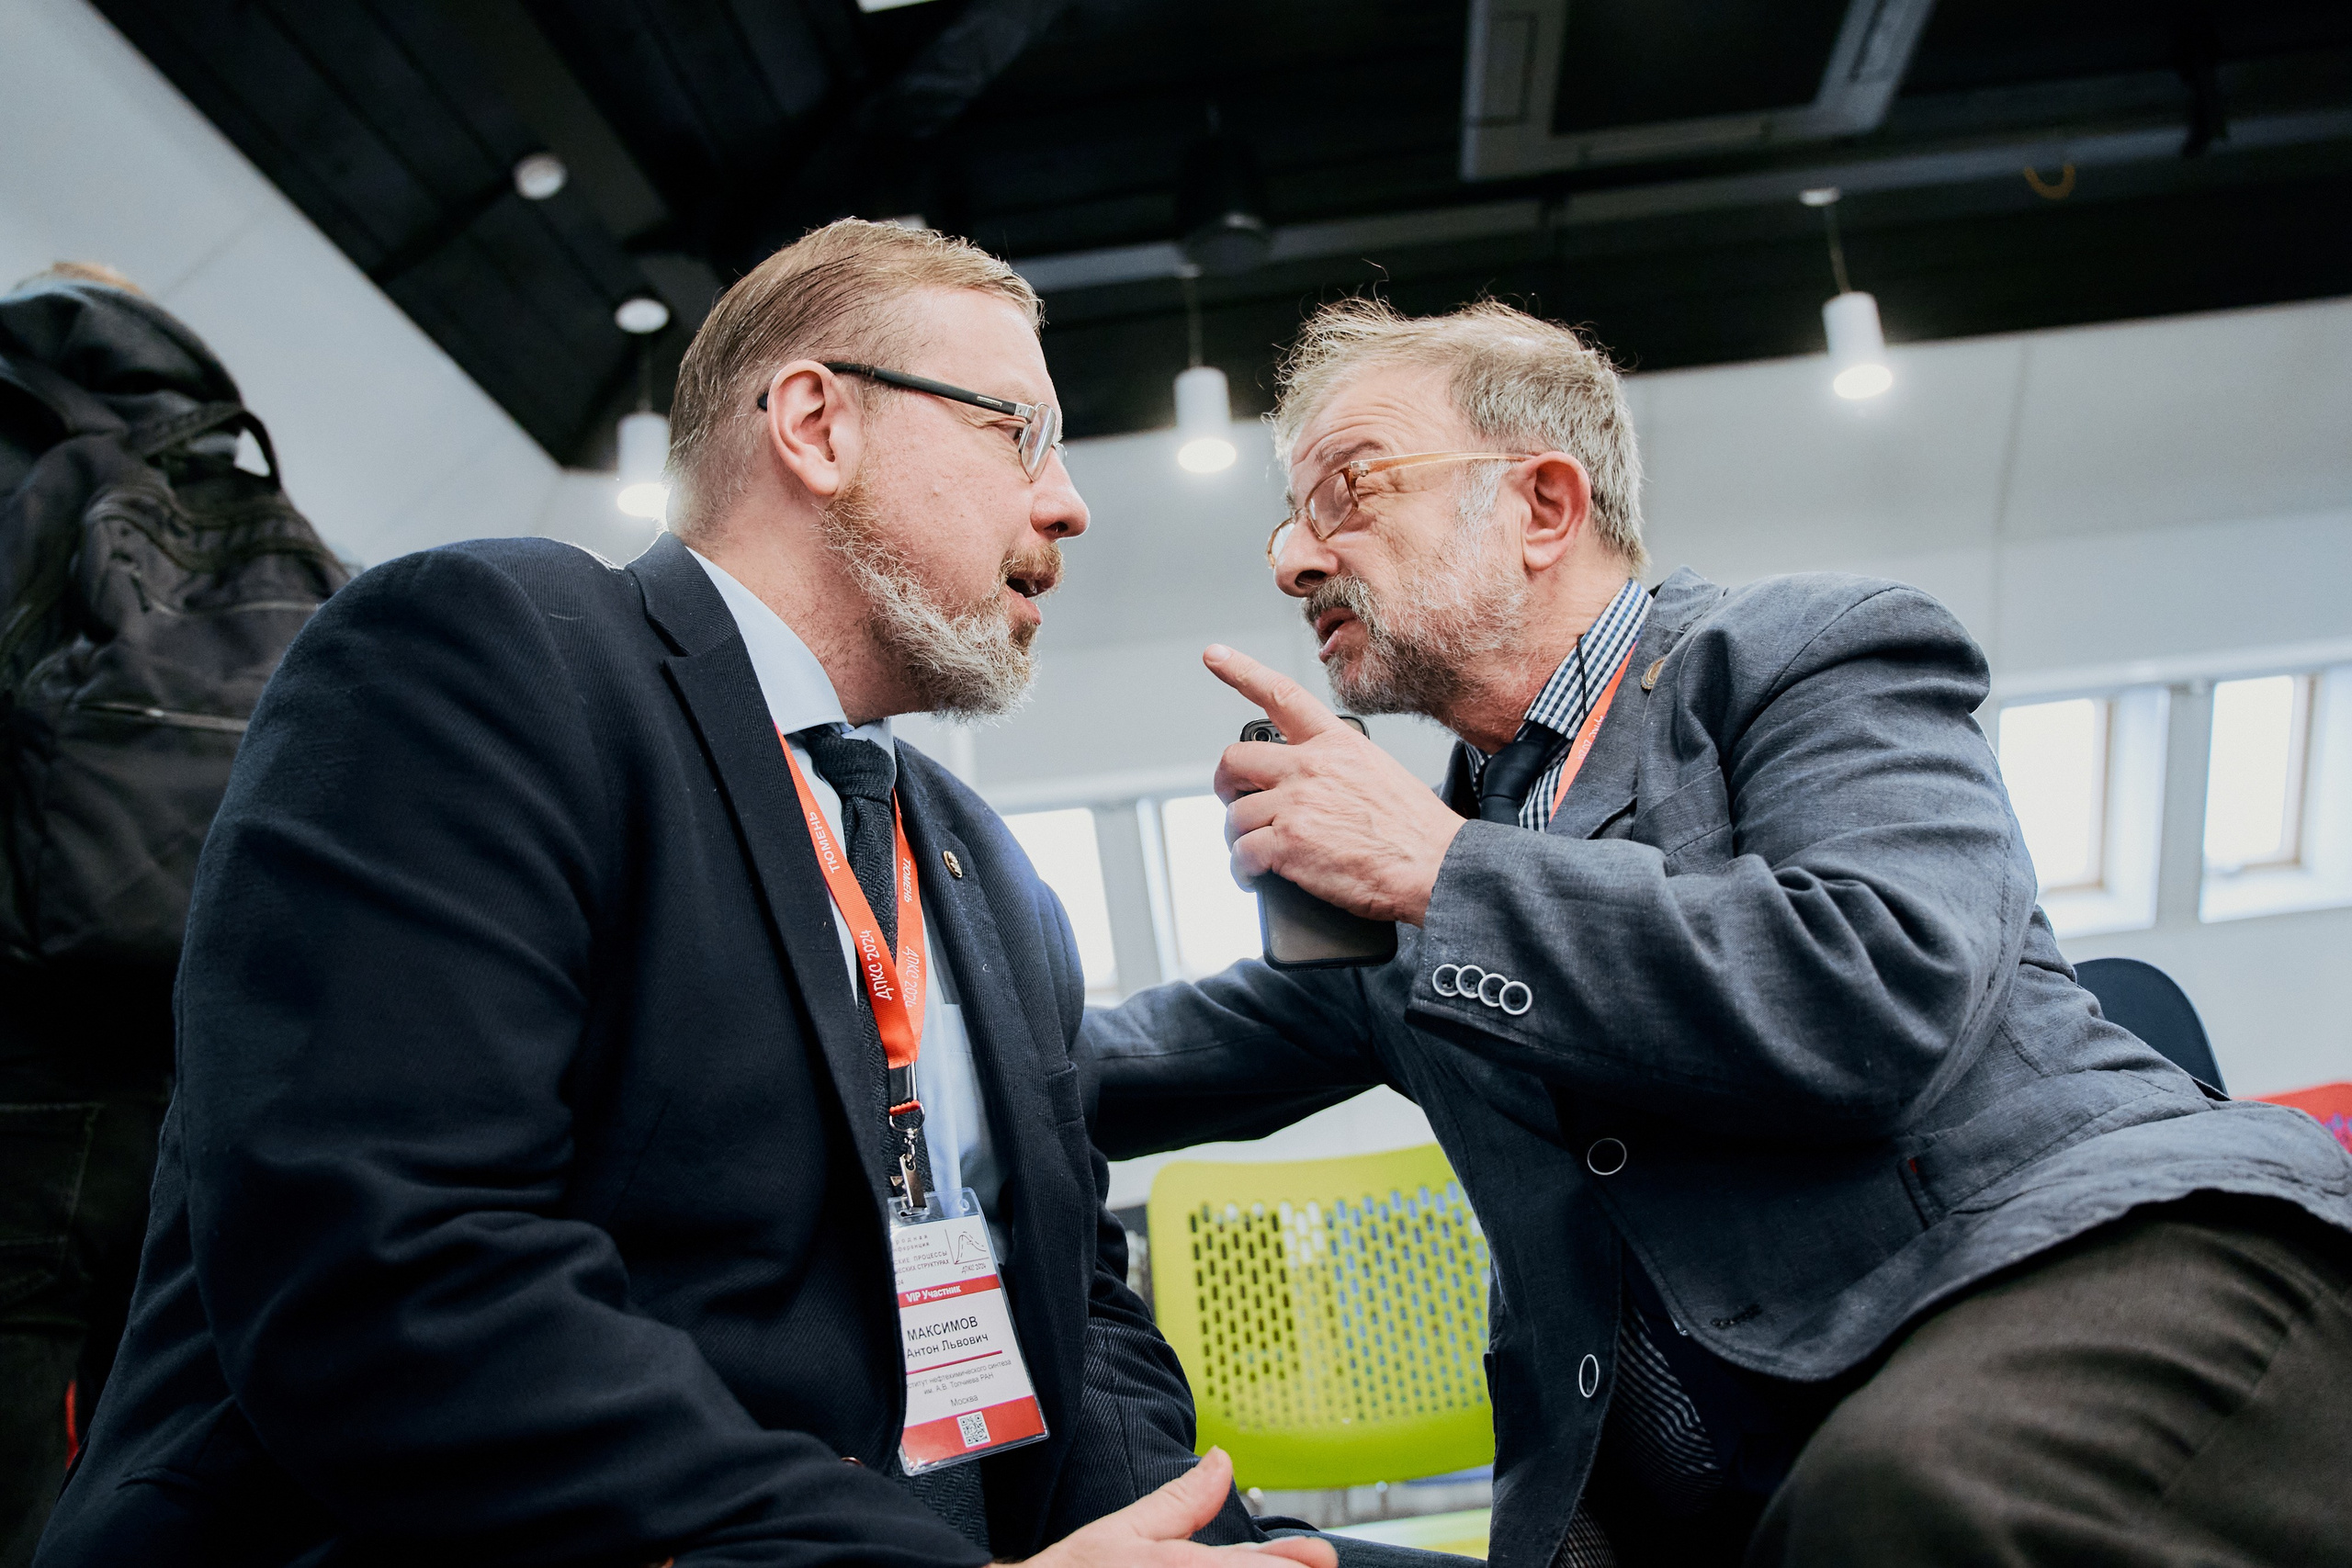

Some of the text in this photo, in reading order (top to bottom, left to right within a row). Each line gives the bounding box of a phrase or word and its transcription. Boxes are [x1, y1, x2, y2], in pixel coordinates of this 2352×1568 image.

[808, 811, 841, 874] ТЮМЕНЬ
[901, 857, 913, 903] ТЮМЕНЬ
[859, 929, 894, 1001] ДПКС 2024
[901, 945, 920, 1008] ДПКС 2024
[913, 1250, 947, 1261] ПРОЦЕССЫ
[917, 1258, 949, 1270] СТРУКТУРАХ
[906, 1285, 962, 1303] VIP Участник
[907, 1315, 978, 1341] МАКСИМОВ
[907, 1334, 989, 1359] Антон Львович
[929, 1366, 987, 1383] нефтехимического
[988, 1359, 1012, 1370] синтеза
[950, 1376, 979, 1389] Топчиева
[980, 1372, 994, 1382] РАН
[950, 1394, 978, 1406] Москва
